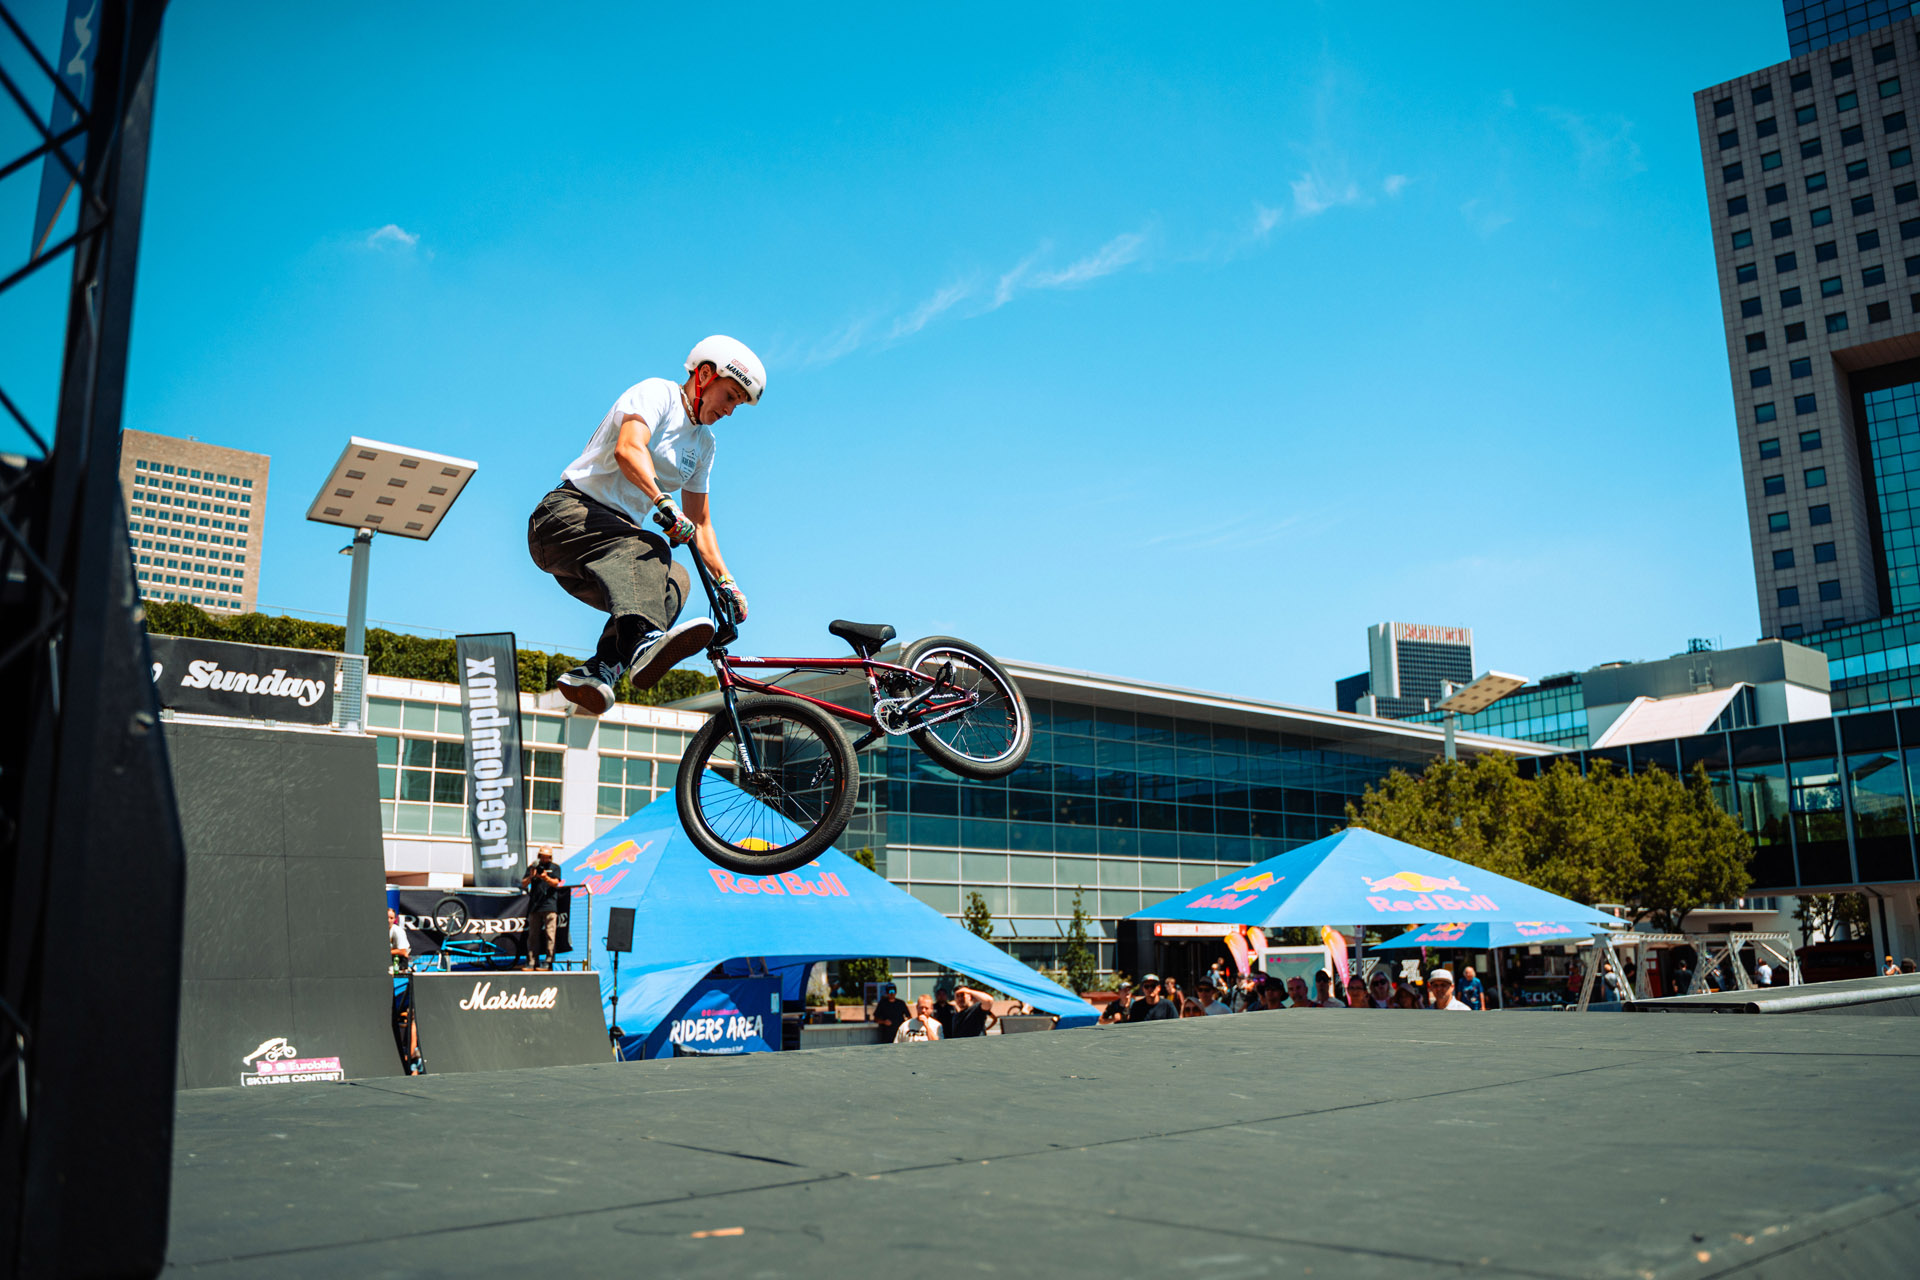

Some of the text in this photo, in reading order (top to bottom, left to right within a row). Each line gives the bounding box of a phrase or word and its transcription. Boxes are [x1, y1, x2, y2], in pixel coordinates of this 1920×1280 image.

[725, 363, 752, 387] MANKIND
[181, 659, 326, 707] Sunday
[708, 869, 850, 896] Red Bull
[1366, 894, 1500, 912] Red Bull
[460, 981, 558, 1010] Marshall
[669, 1014, 763, 1044] RIDERS AREA
[289, 1060, 337, 1071] Eurobike
[246, 1072, 340, 1086] SKYLINE CONTEST
